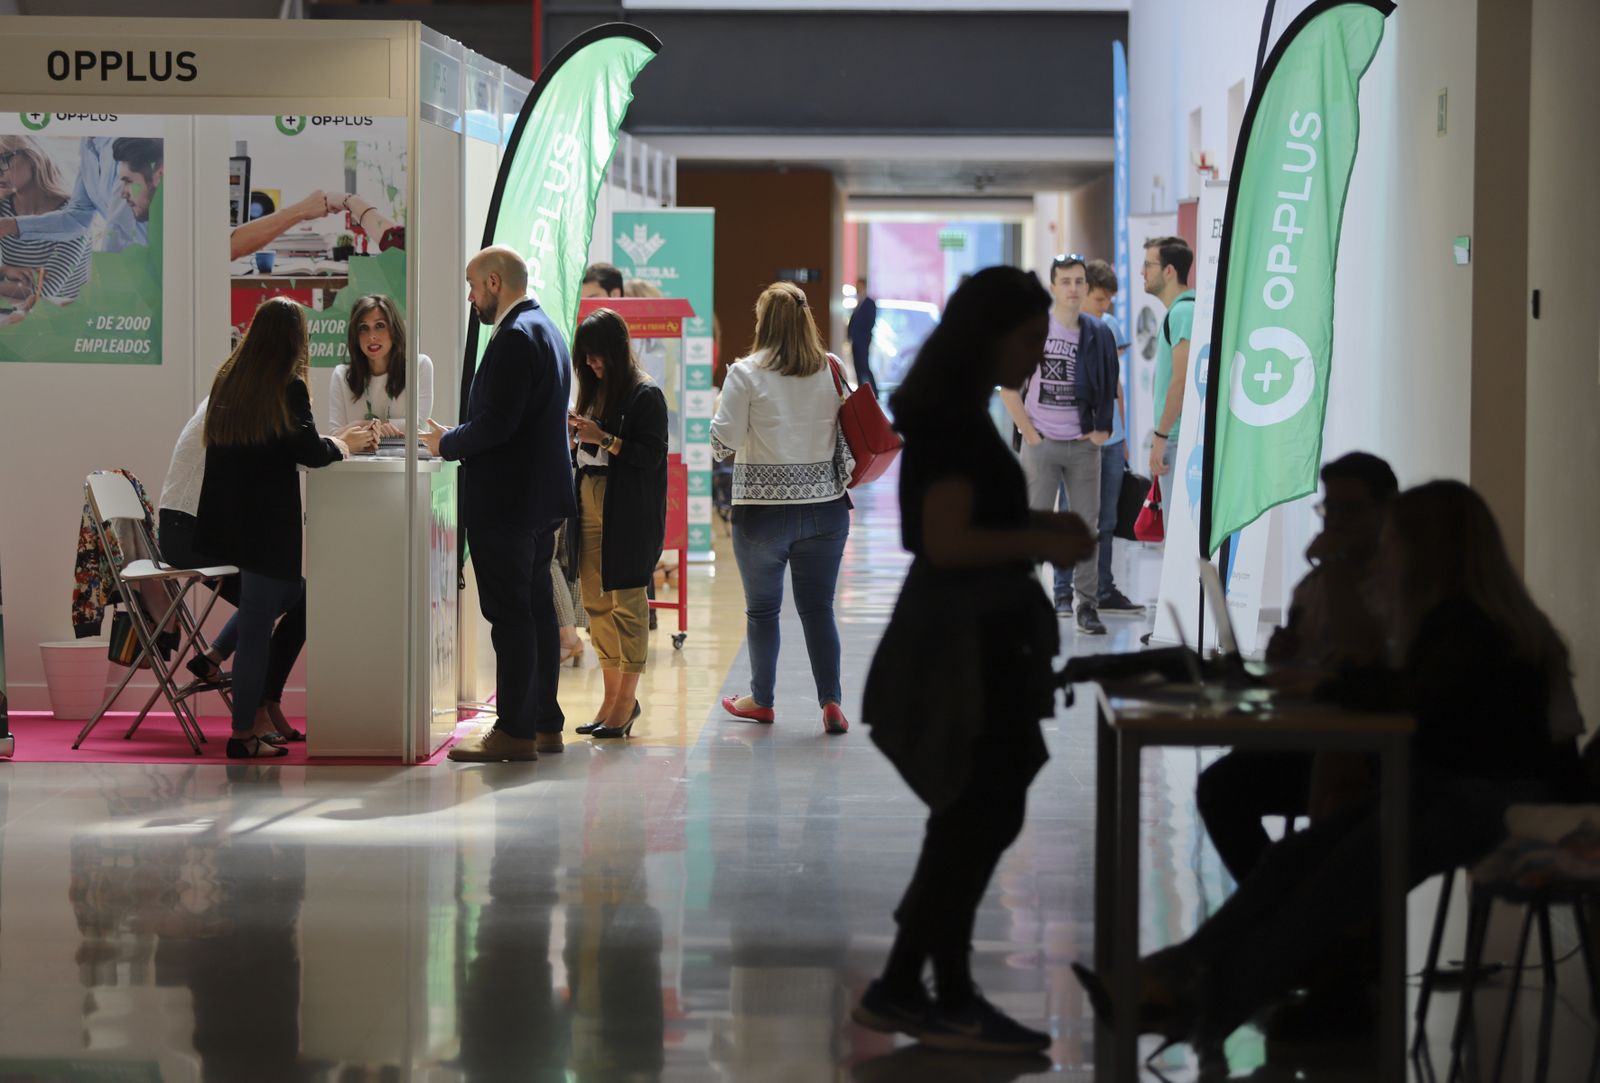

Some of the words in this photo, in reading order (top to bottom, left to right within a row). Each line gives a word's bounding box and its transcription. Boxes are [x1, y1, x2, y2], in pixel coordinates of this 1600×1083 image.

[47, 50, 197, 82] OPPLUS
[311, 115, 373, 126] OPPLUS
[527, 131, 581, 300] PPLUS
[1263, 110, 1321, 310] OPPLUS
[96, 316, 114, 330] DE
[116, 316, 151, 331] 2000
[74, 338, 151, 354] EMPLEADOS
[1044, 340, 1078, 358] MOSC
